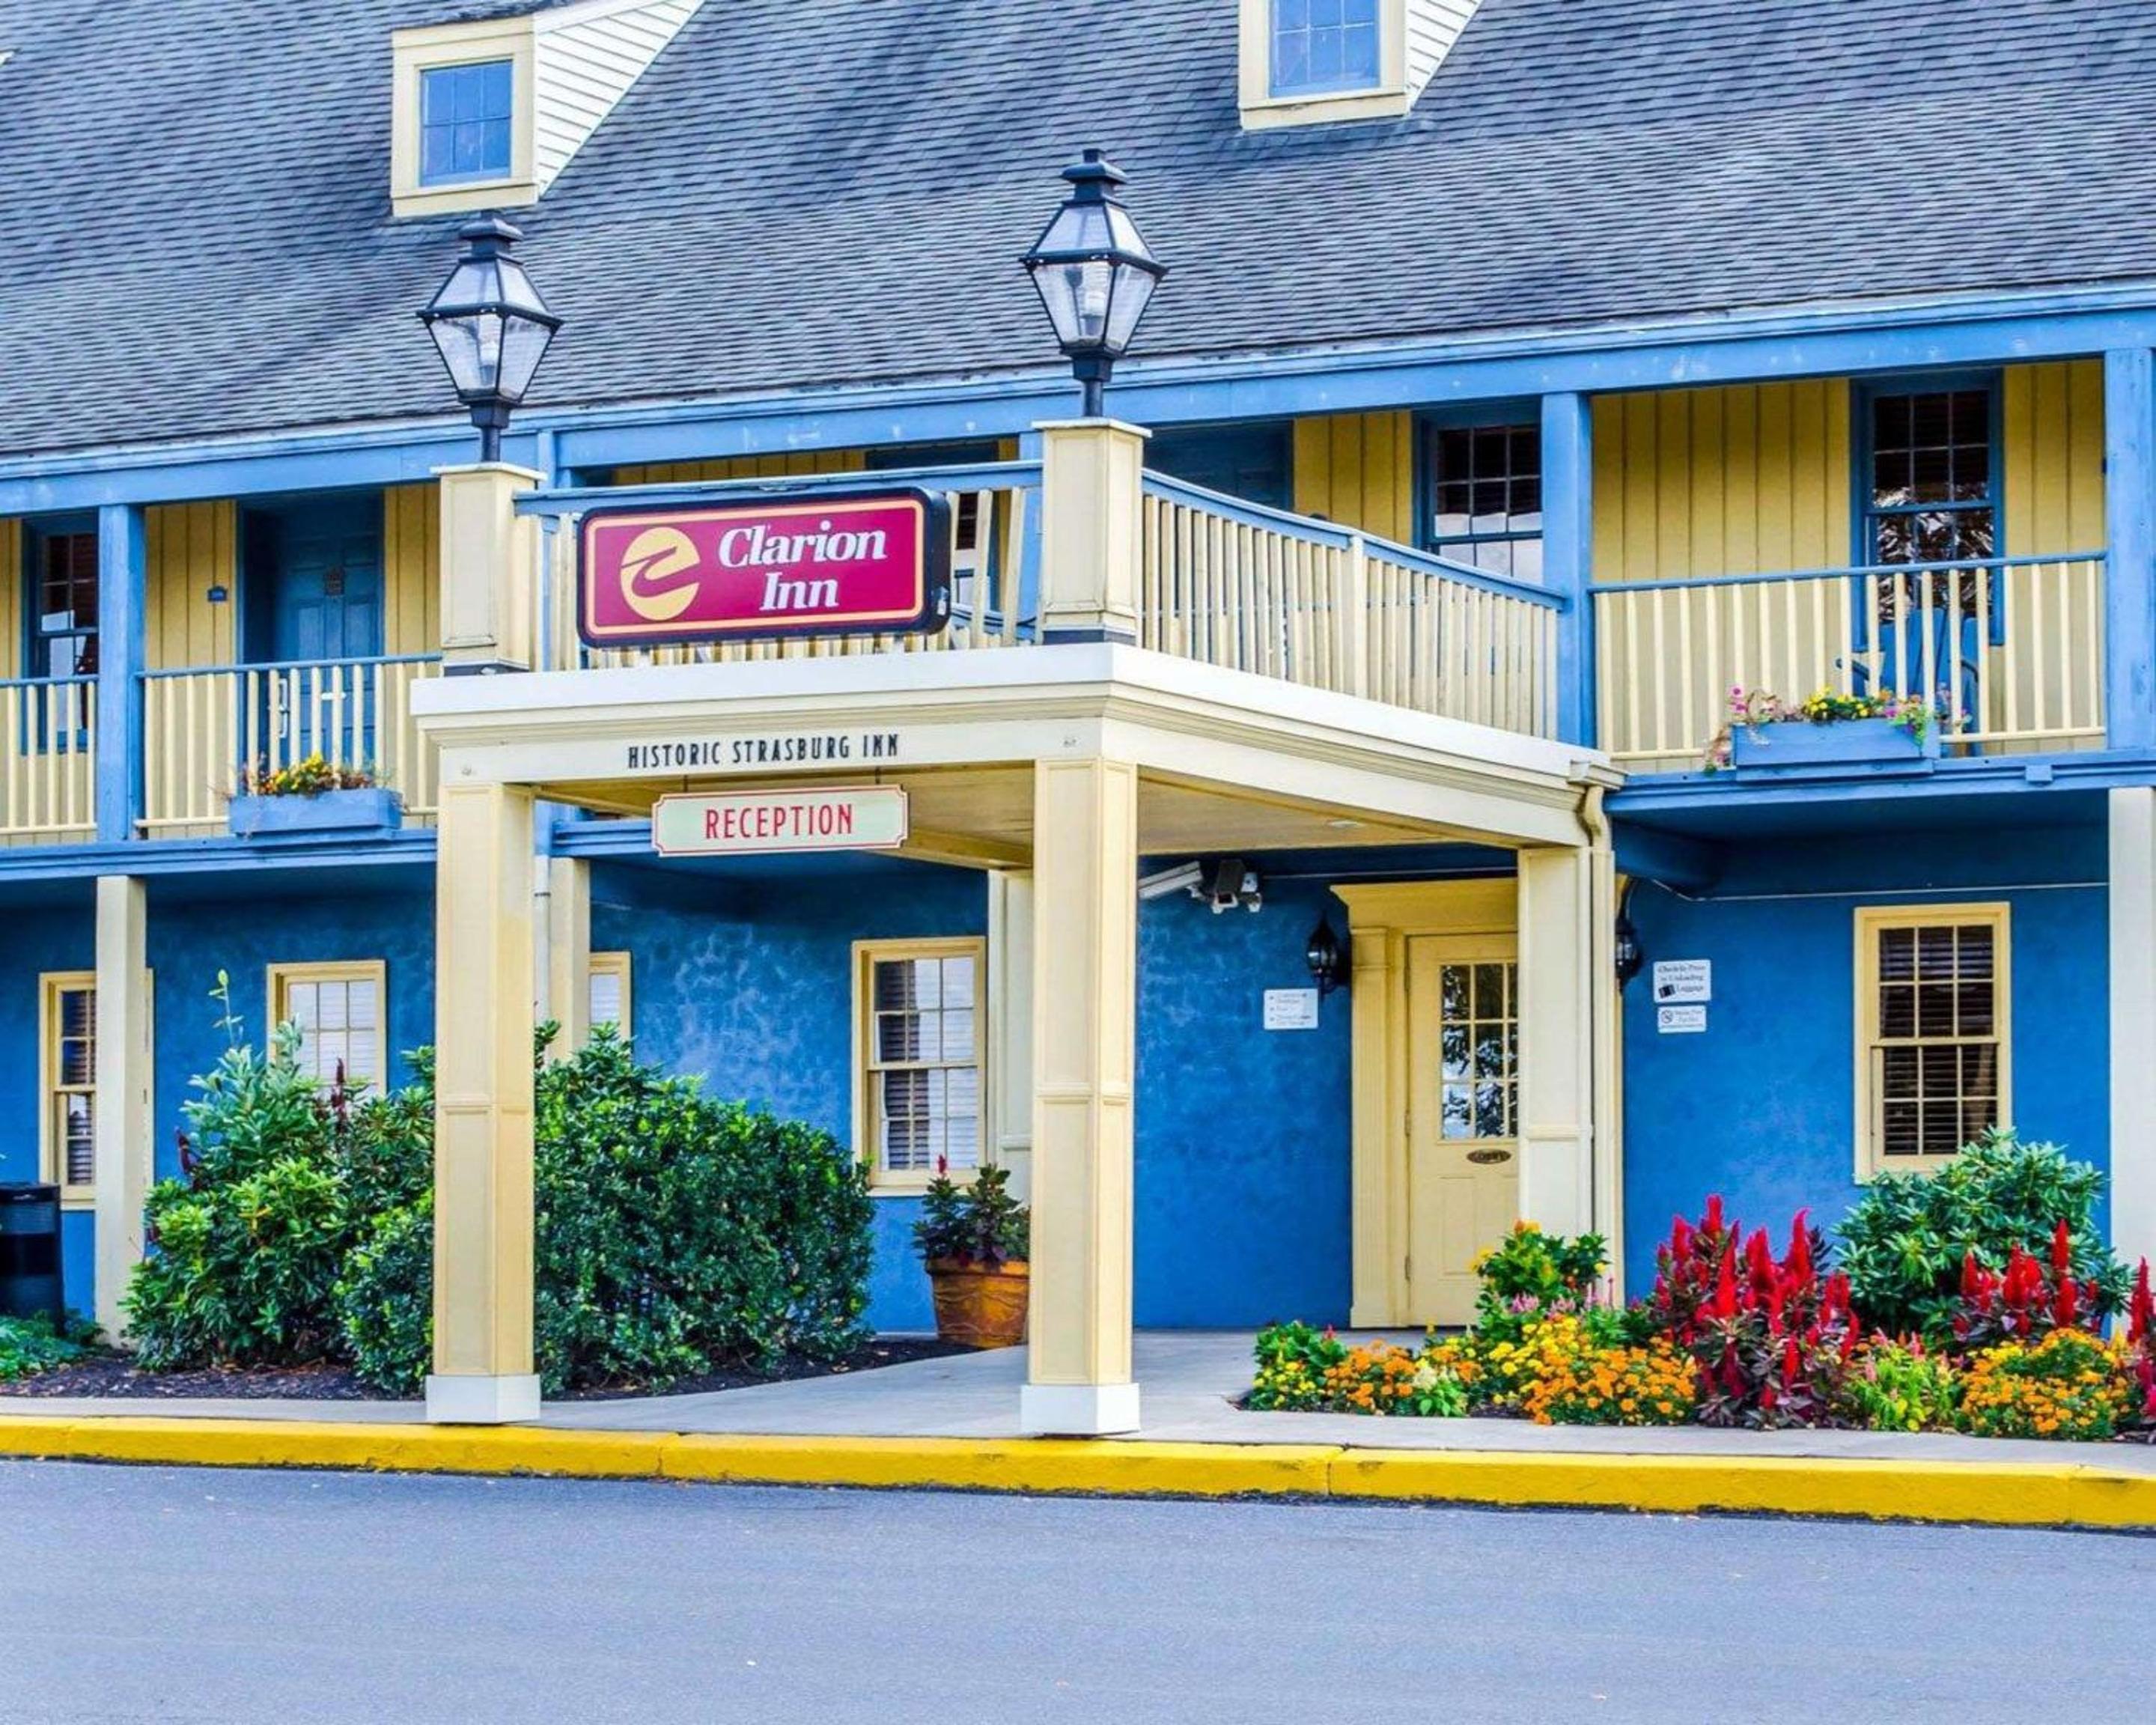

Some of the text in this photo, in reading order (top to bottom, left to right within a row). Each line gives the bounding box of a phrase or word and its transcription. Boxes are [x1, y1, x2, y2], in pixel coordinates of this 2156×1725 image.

[719, 520, 887, 569] Clarion
[759, 572, 838, 612] Inn
[627, 734, 899, 769] HISTORIC STRASBURG INN
[705, 803, 853, 839] RECEPTION
